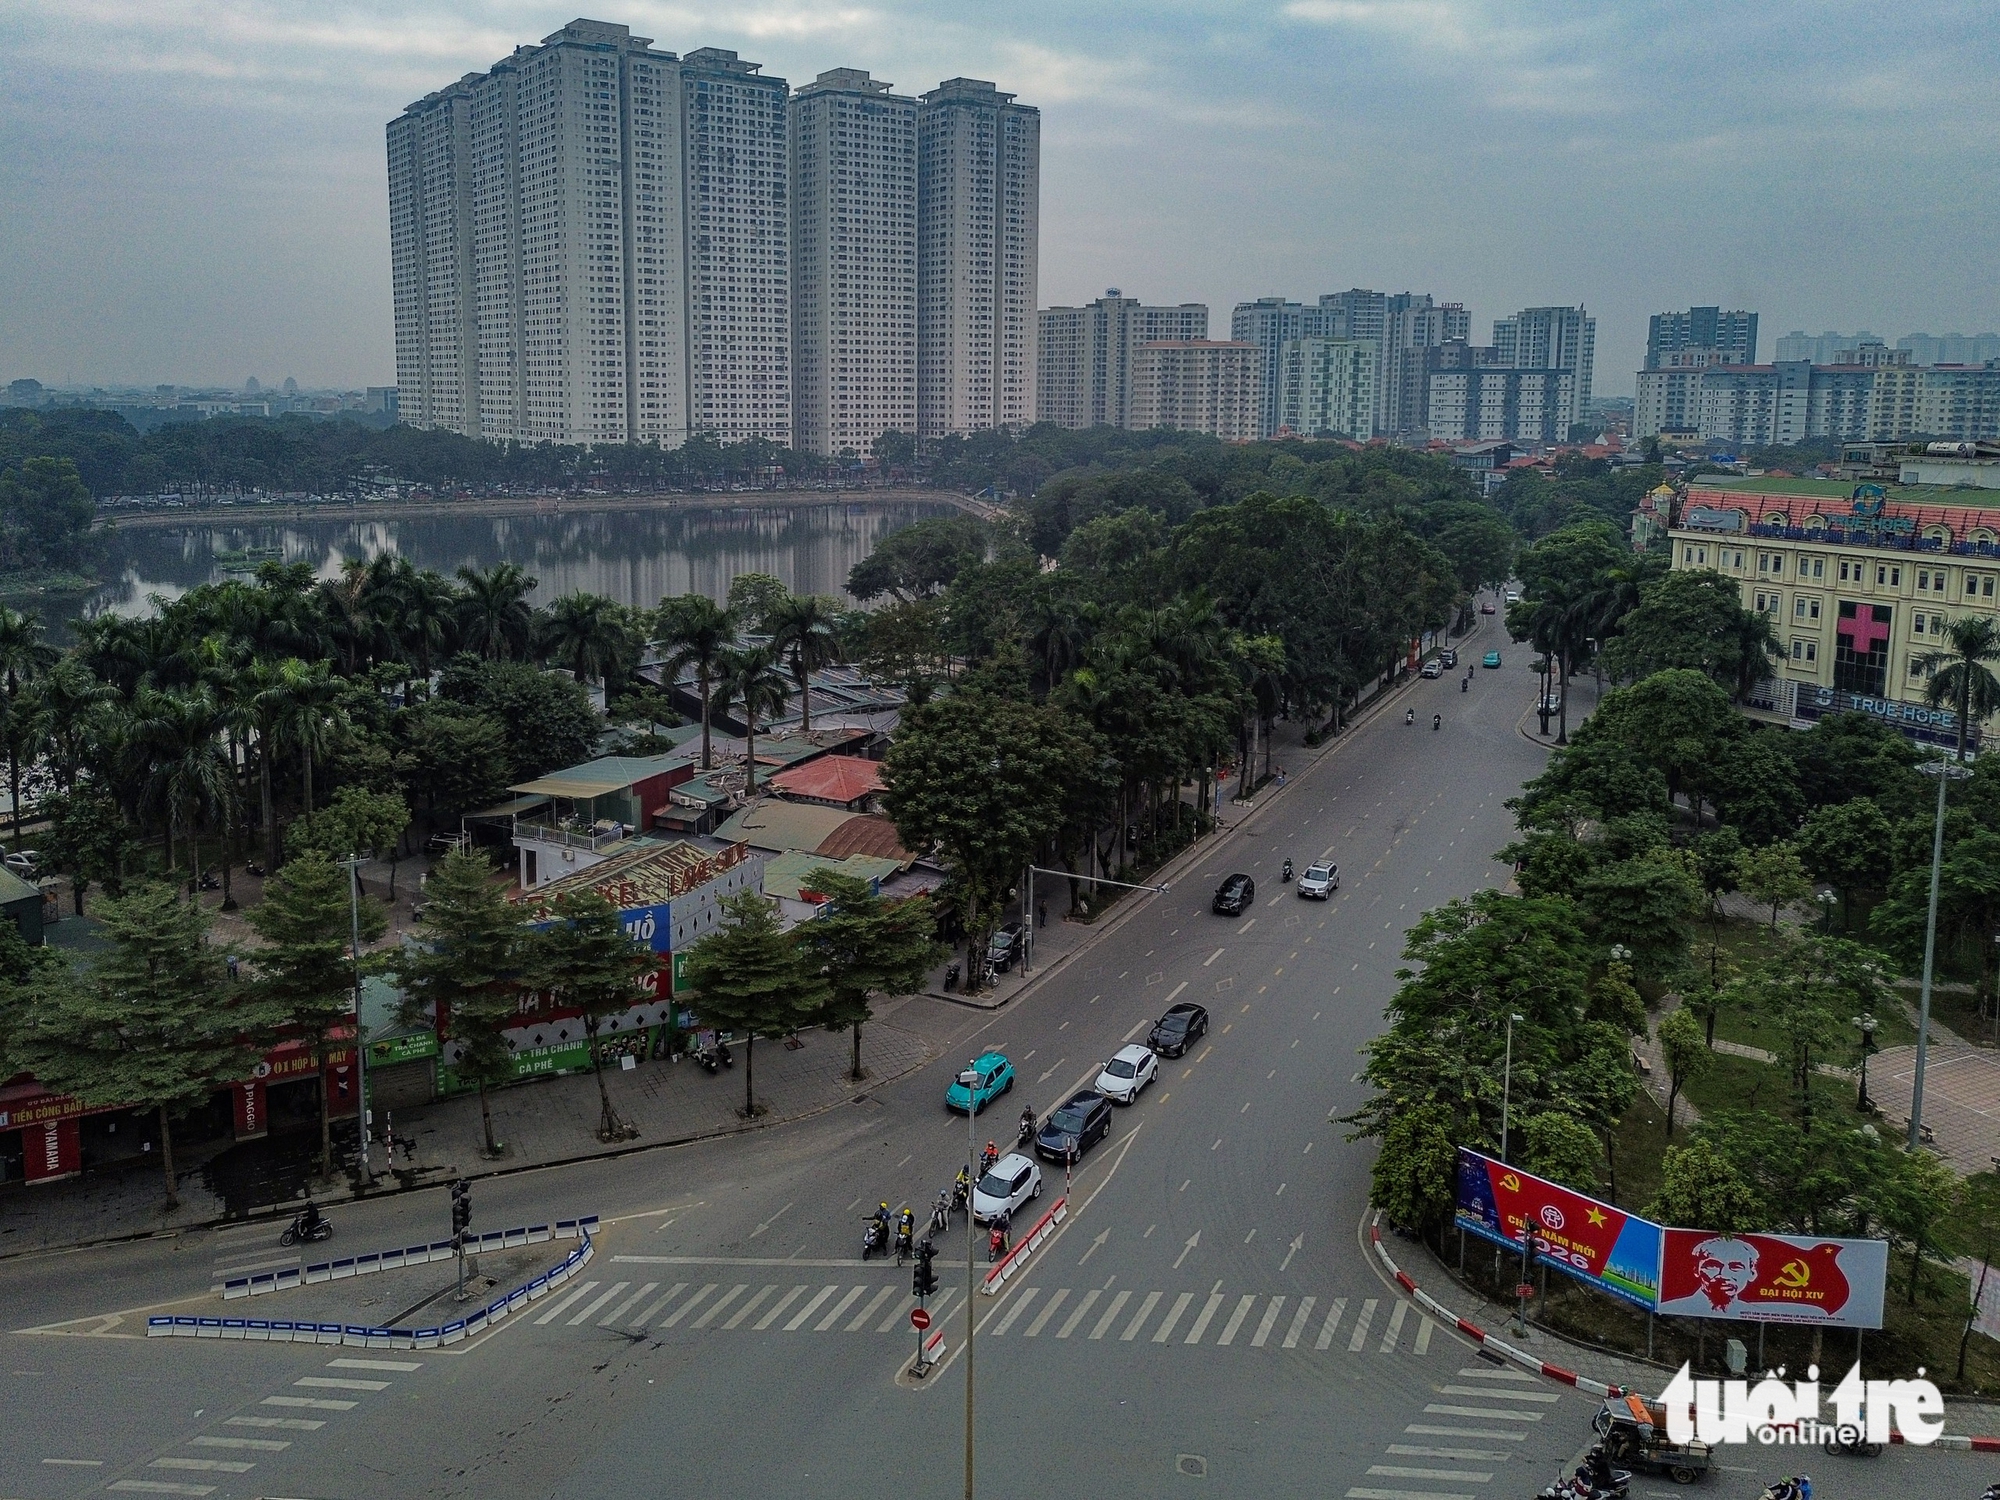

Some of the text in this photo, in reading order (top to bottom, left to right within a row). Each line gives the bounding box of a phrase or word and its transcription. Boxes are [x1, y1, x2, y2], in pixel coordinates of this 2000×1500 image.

[1825, 514, 1916, 533] TRUE HOPE
[1850, 696, 1956, 728] TRUE HOPE
[669, 838, 749, 897] LAKE SIDE
[550, 1040, 583, 1054] CHANH
[291, 1056, 309, 1073] HỘP
[519, 1058, 554, 1074] CÀ PHÊ
[35, 1104, 61, 1119] CÔNG
[245, 1091, 255, 1131] PIAGGIO
[44, 1128, 60, 1171] YAMAHA
[1541, 1229, 1569, 1247] NĂM
[1572, 1241, 1596, 1259] MỚI
[1760, 1286, 1825, 1301] ĐẠI HỘI XIV
